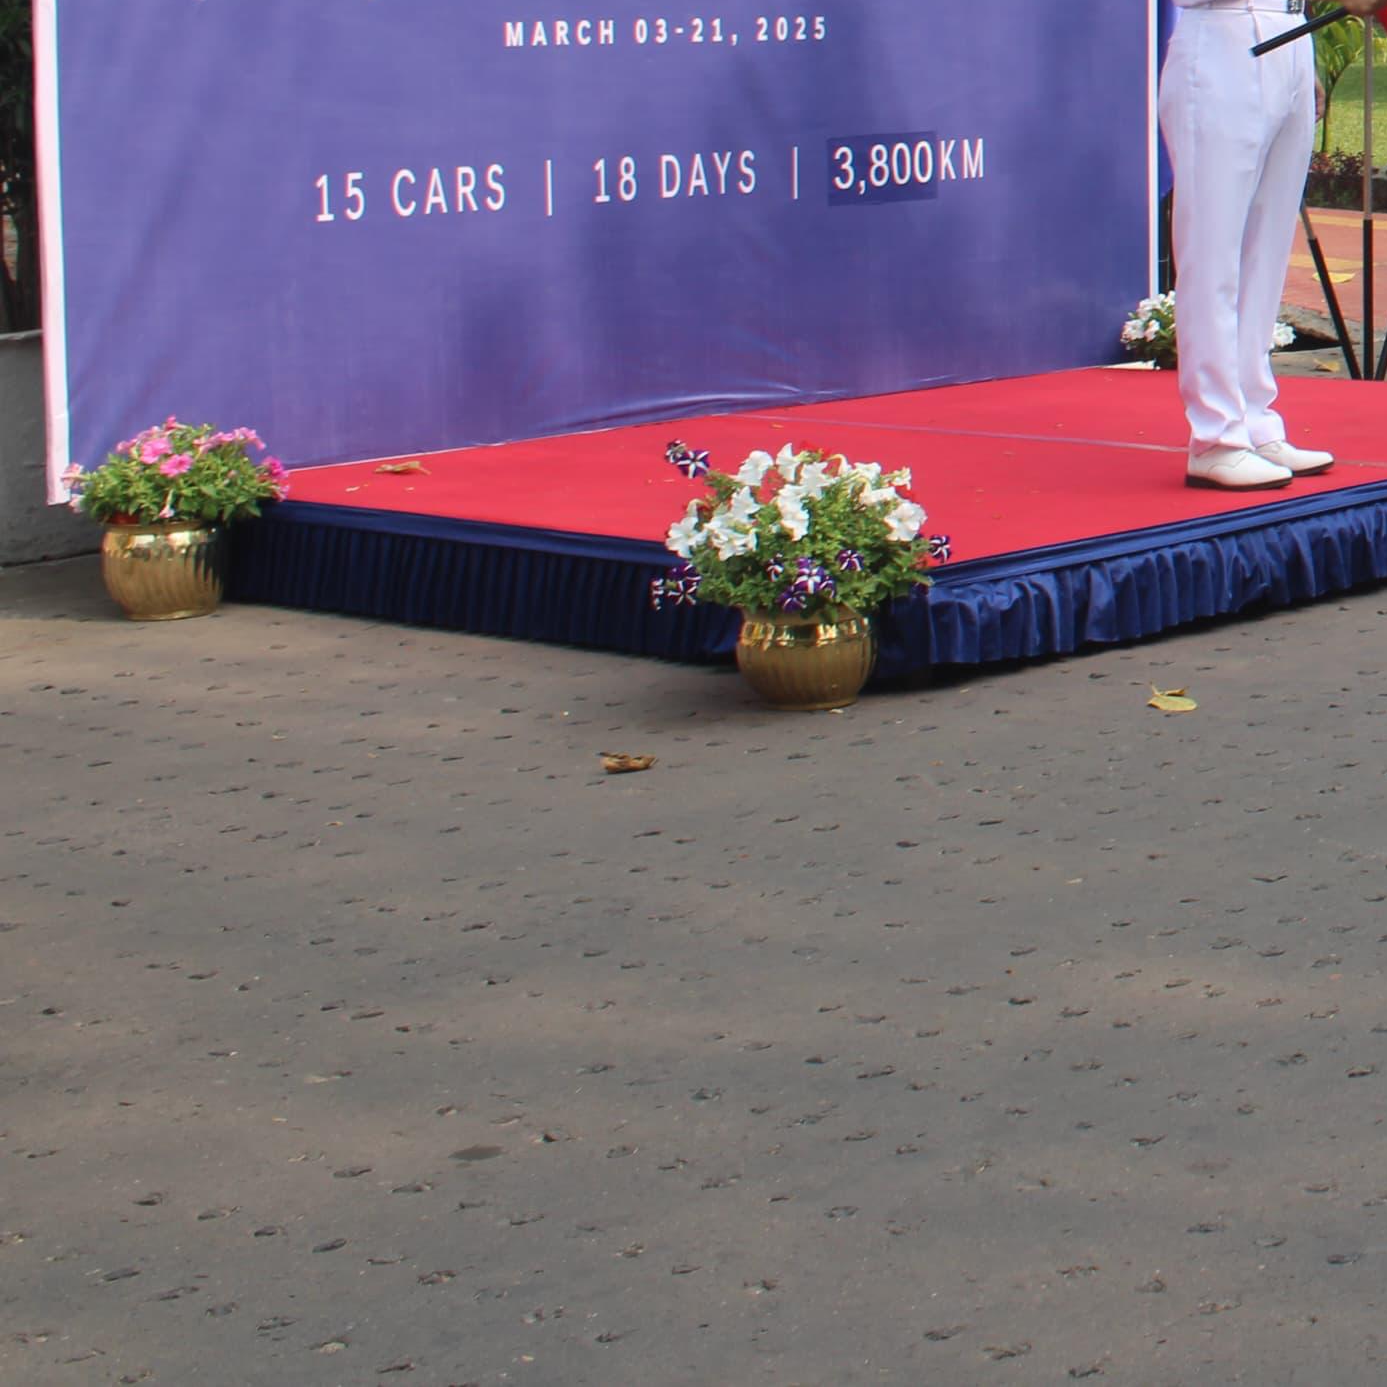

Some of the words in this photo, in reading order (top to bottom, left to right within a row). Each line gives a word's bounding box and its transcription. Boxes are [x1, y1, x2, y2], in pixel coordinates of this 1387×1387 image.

[504, 20, 615, 47] MARCH
[634, 17, 739, 46] 03-21,
[756, 16, 828, 42] 2025
[314, 171, 366, 223] 15
[390, 164, 506, 217] CARS
[592, 156, 638, 204] 18
[659, 150, 757, 199] DAYS
